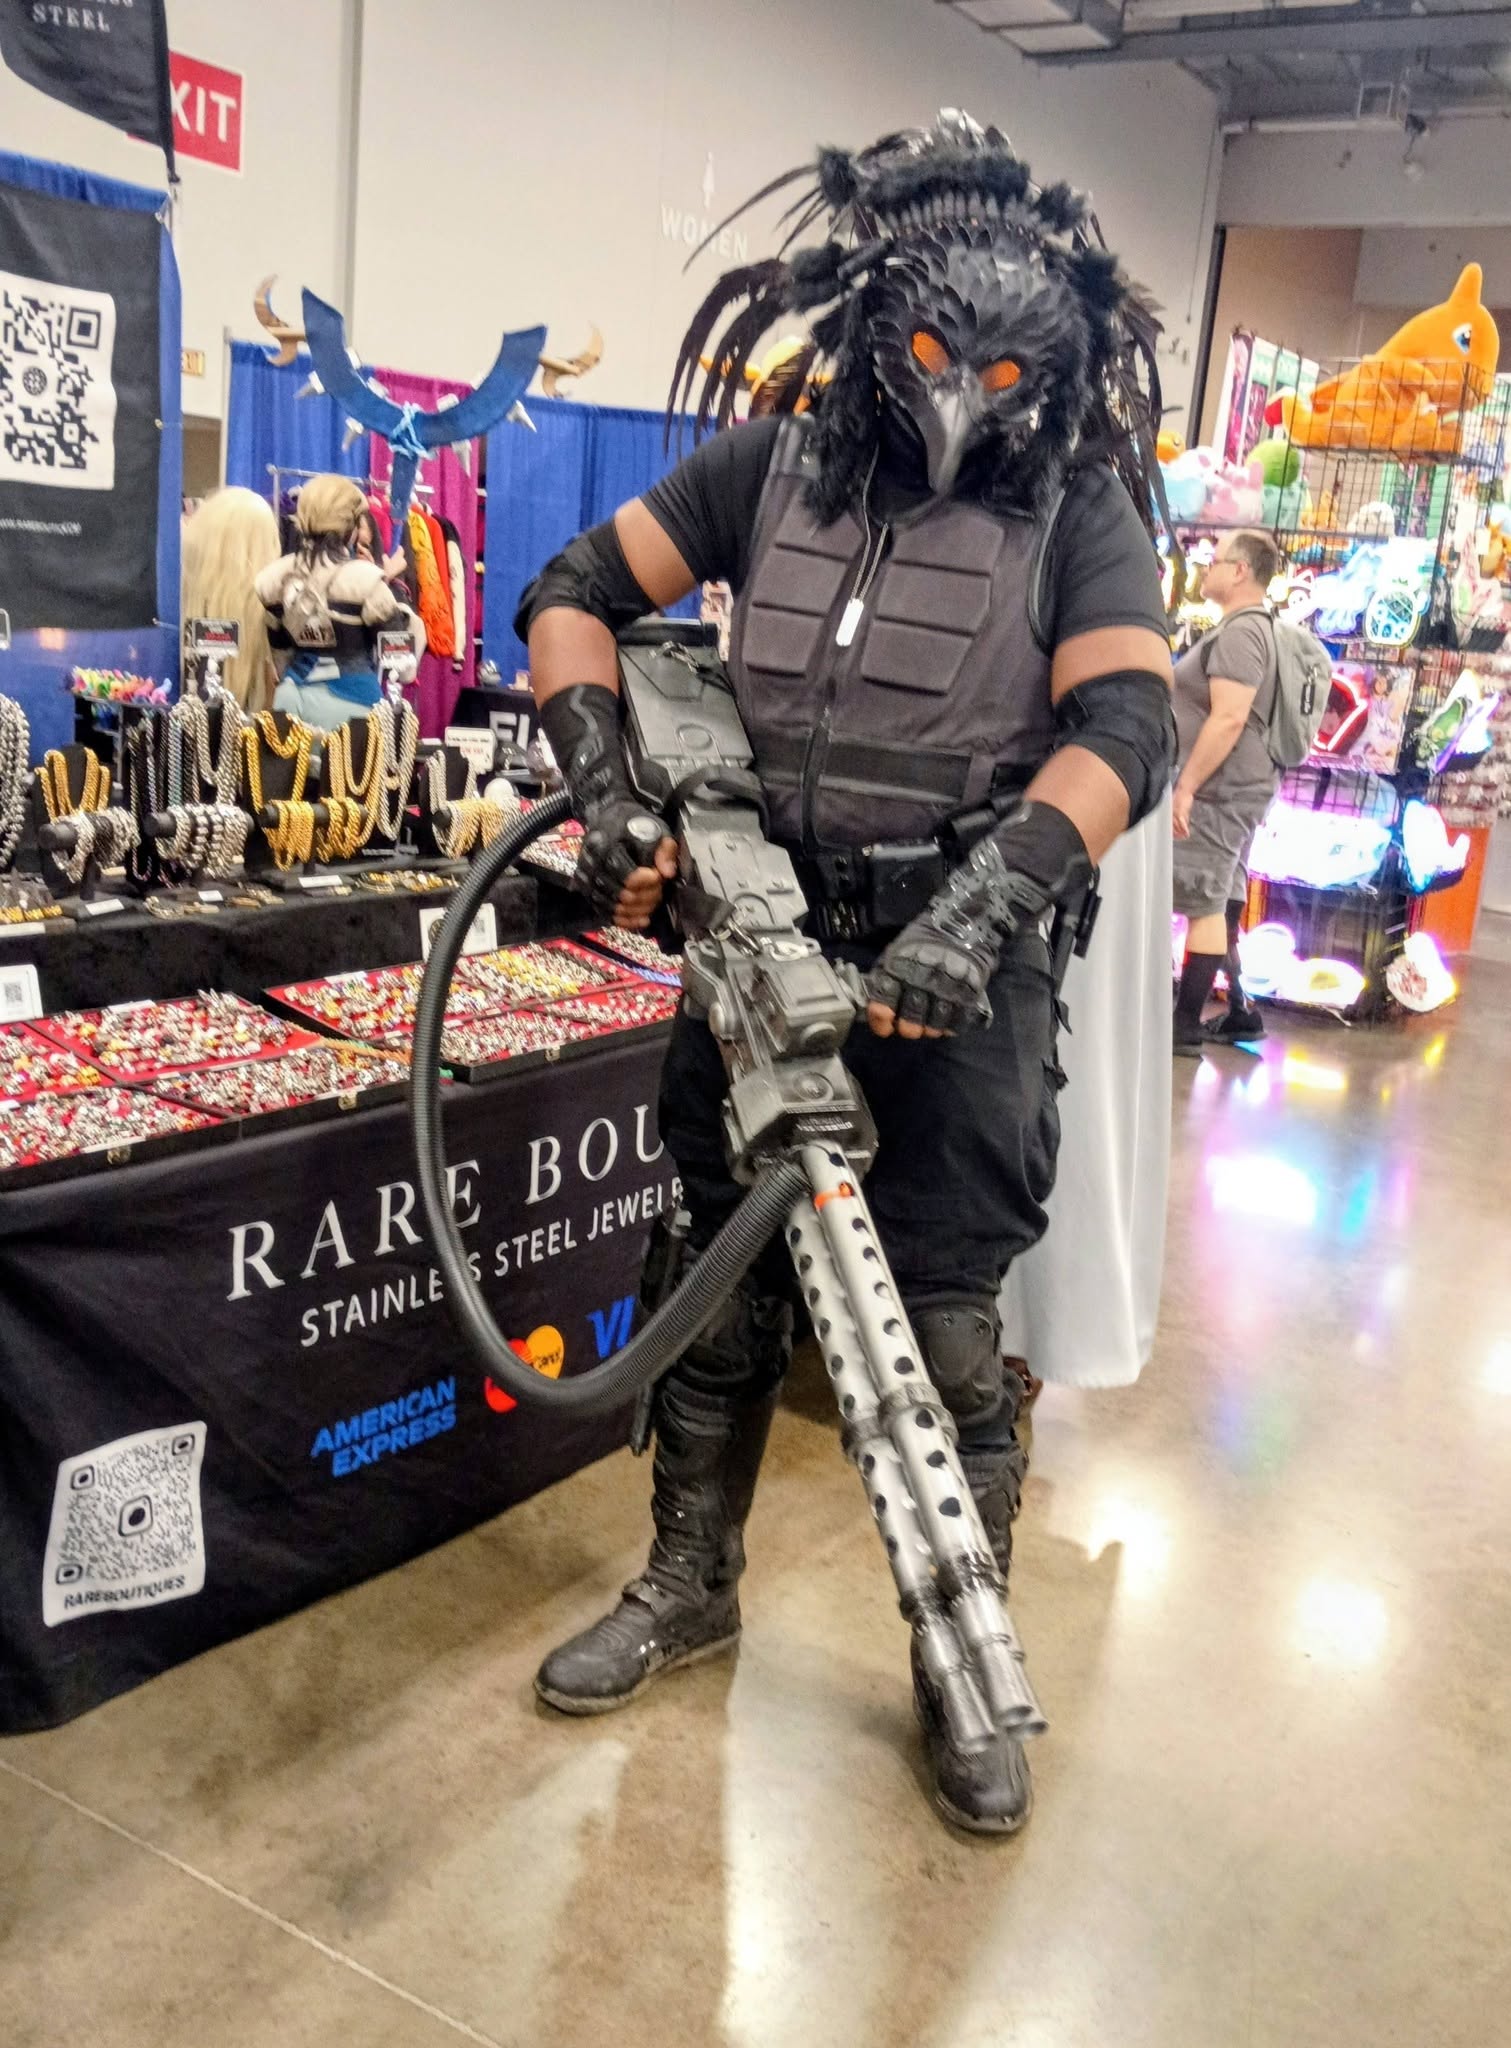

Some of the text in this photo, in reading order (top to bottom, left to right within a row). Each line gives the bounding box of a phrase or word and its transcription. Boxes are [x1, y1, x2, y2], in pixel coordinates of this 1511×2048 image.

[33, 2, 111, 33] STEEL
[169, 79, 237, 143] XIT
[659, 202, 749, 261] WOMEN
[226, 1103, 665, 1302] RARE BOU
[300, 1250, 482, 1348] STAINLES
[494, 1216, 577, 1278] STEEL
[586, 1294, 637, 1359] VI
[311, 1374, 457, 1458] AMERICAN
[332, 1402, 457, 1478] EXPRESS
